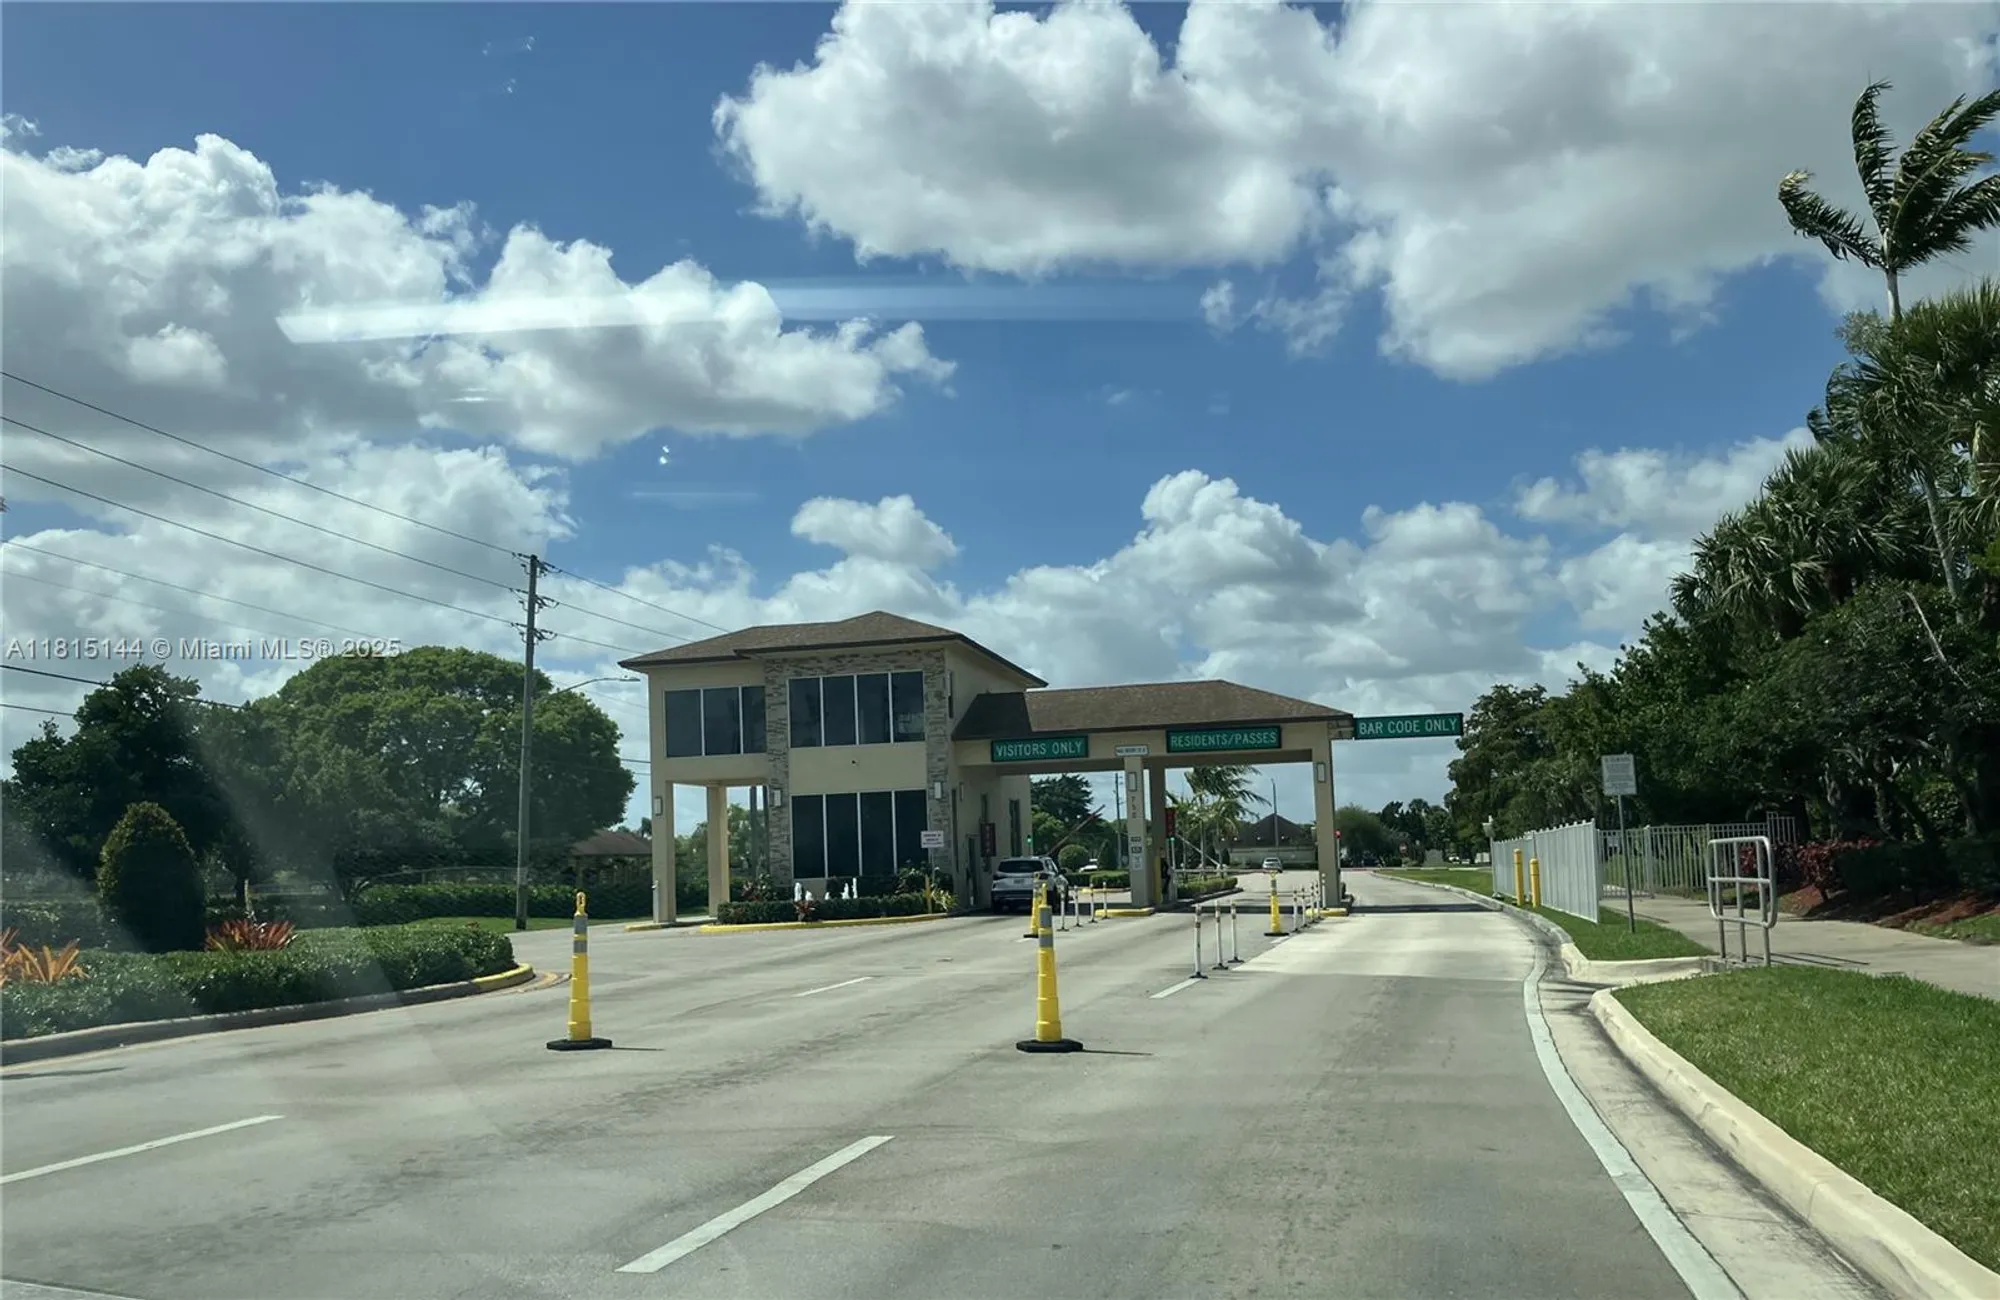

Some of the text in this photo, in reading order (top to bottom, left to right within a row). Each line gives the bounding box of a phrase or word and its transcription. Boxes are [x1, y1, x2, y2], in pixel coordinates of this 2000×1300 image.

[1359, 718, 1458, 735] BAR CODE ONLY
[1170, 731, 1277, 748] RESIDENTS/PASSES
[995, 741, 1083, 757] VISITORS ONLY
